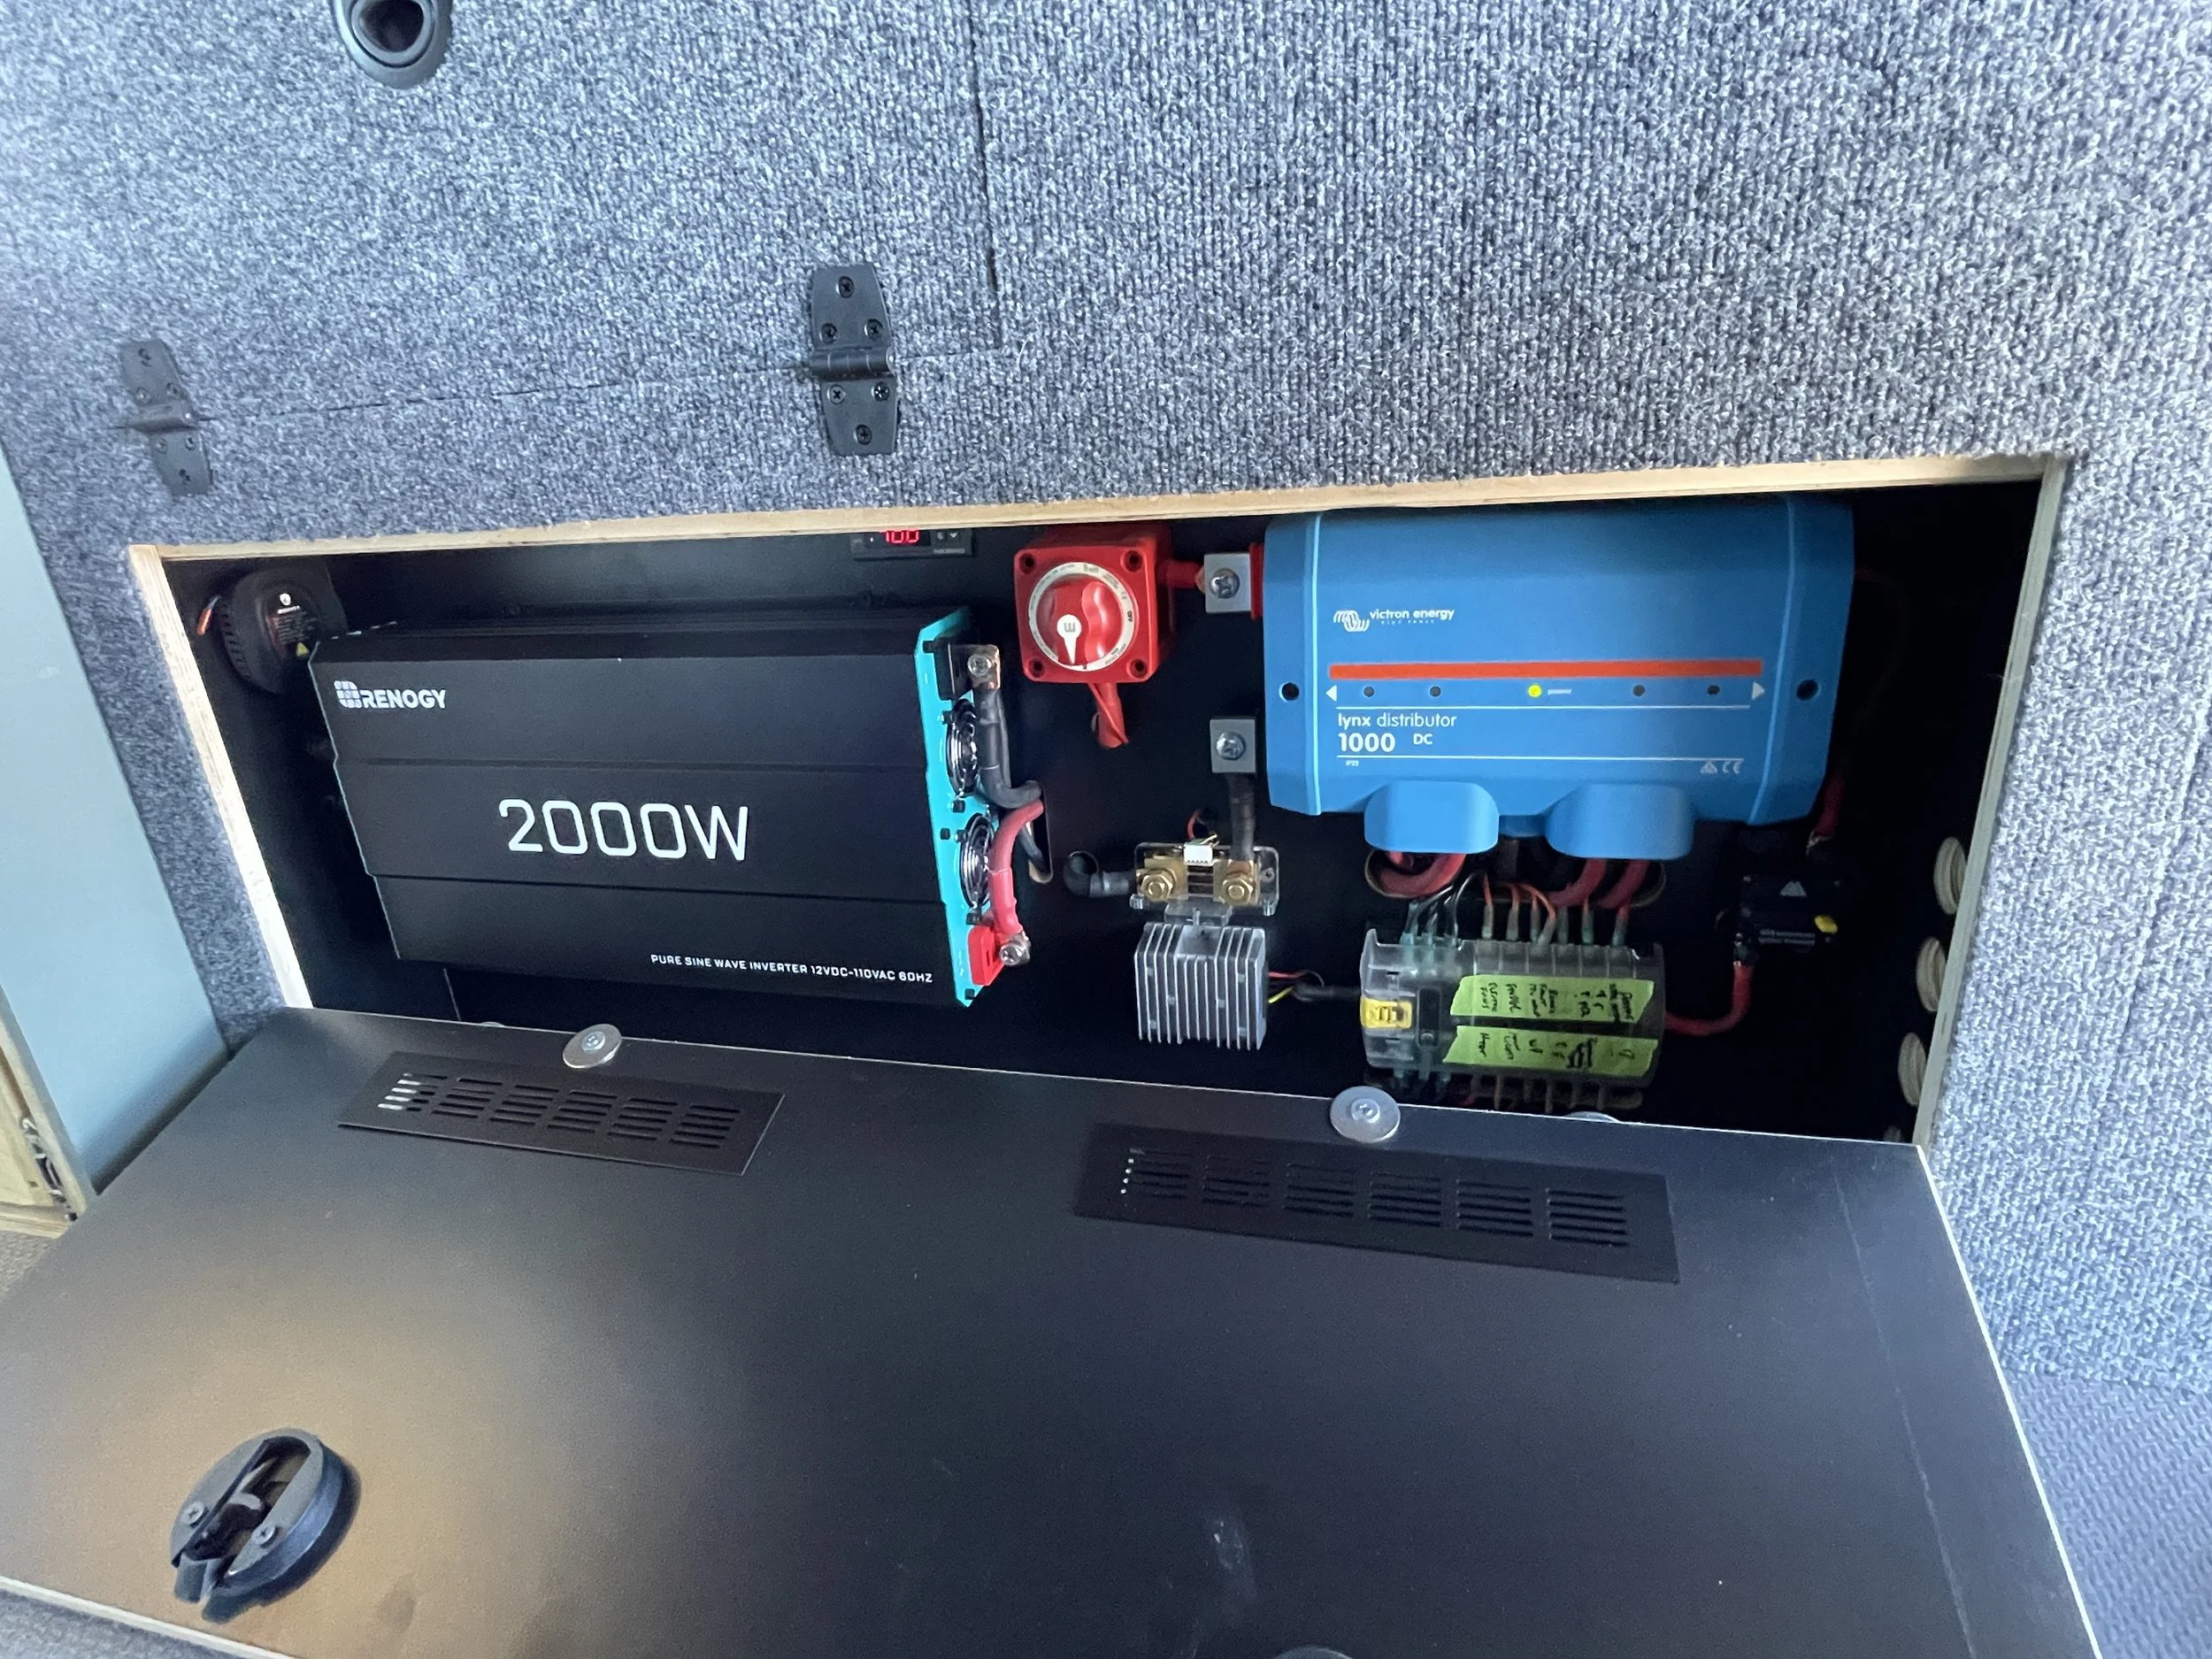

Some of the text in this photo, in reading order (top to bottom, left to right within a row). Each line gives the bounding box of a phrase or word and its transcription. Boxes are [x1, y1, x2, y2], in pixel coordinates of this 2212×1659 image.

[1369, 608, 1455, 621] victron energy
[359, 689, 446, 709] RENOGY
[1337, 711, 1458, 731] lynx distributor
[1337, 732, 1433, 753] 1000 DC
[498, 798, 749, 862] 2000W
[650, 954, 933, 983] PURE SINE WAVE INVERTER 12VDC-110VAC 60HZ
